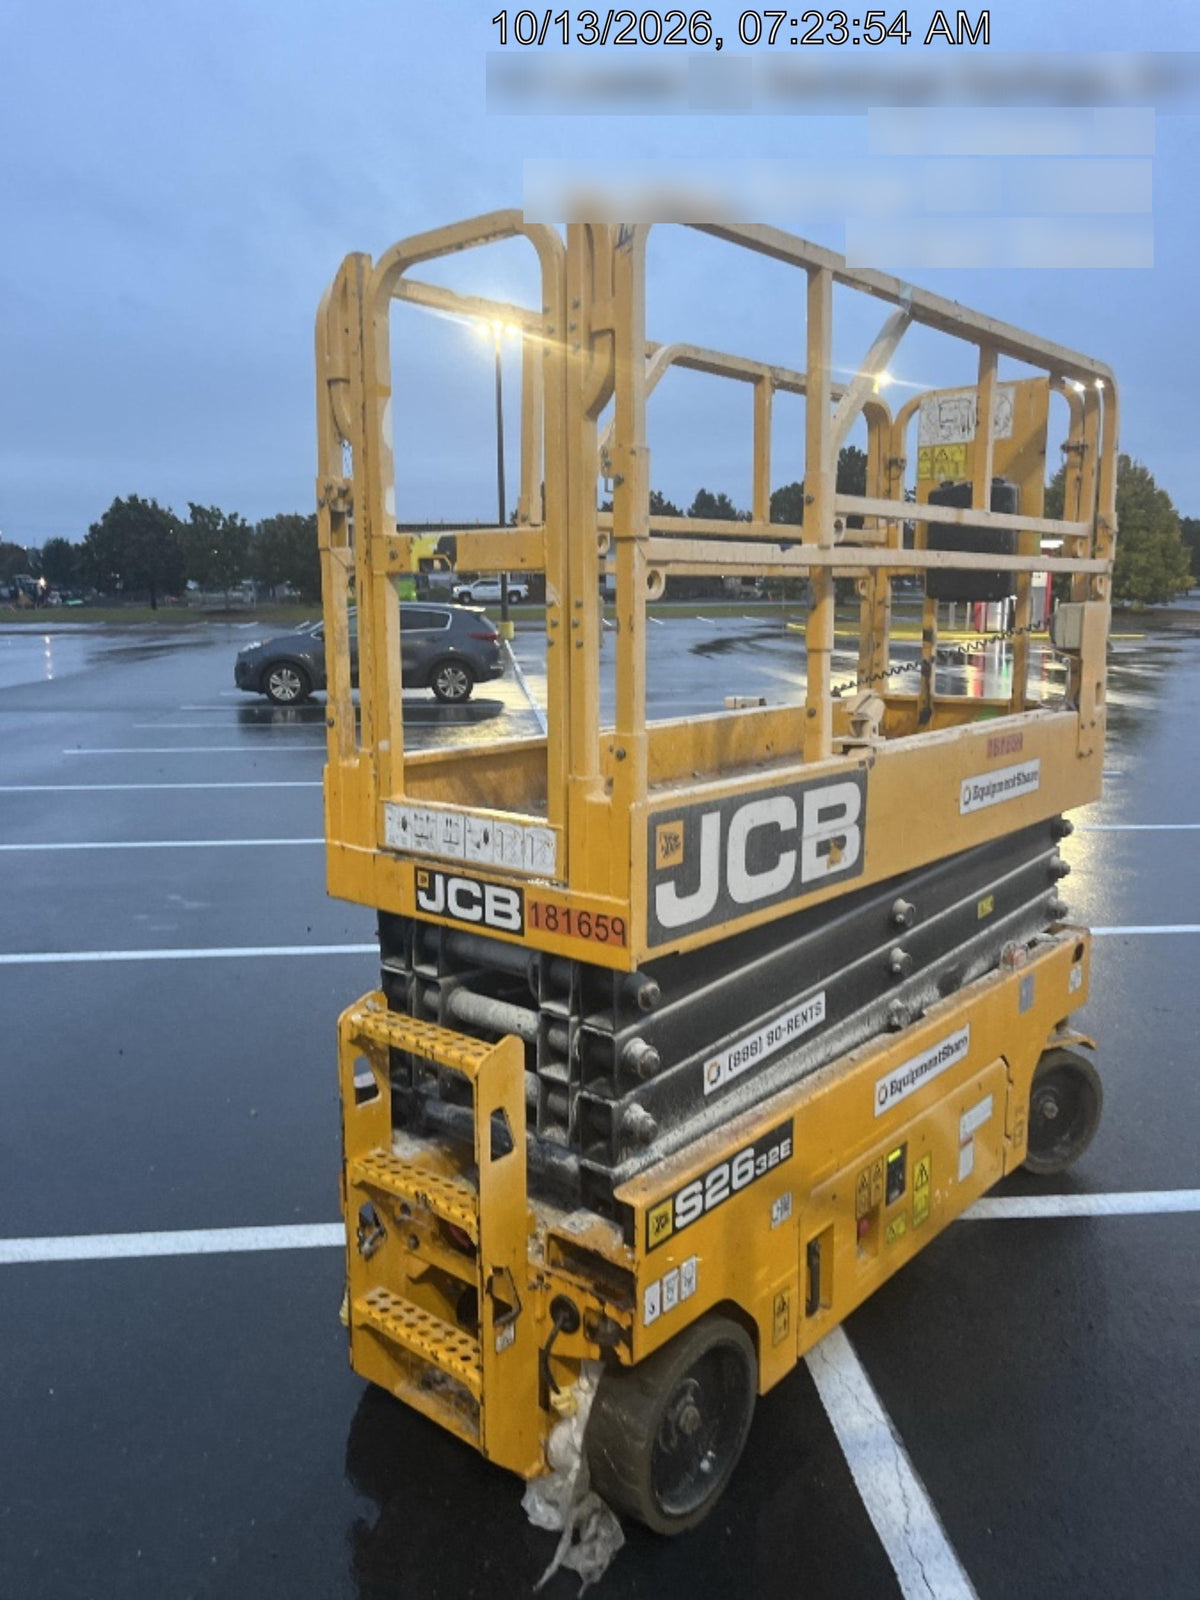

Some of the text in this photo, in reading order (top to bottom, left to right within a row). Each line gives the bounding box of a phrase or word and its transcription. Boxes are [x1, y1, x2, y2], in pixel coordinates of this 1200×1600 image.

[655, 781, 861, 928] JCB
[417, 873, 522, 931] JCB
[530, 901, 627, 947] 181659
[766, 1001, 822, 1047] 80-RENTS
